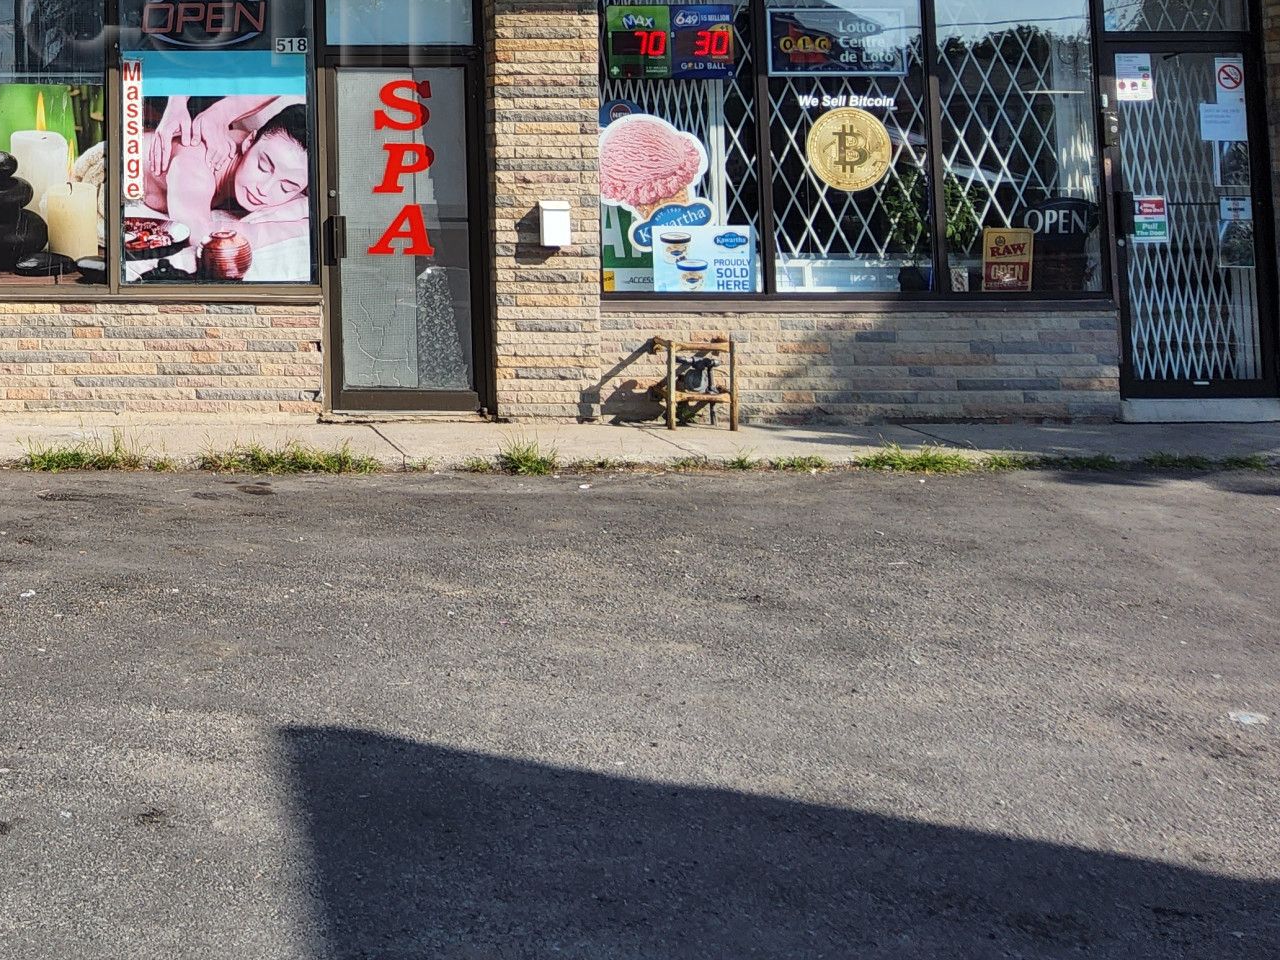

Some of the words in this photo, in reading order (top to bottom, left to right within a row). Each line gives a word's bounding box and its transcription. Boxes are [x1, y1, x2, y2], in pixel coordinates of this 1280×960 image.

[142, 1, 265, 33] OPEN
[838, 22, 876, 33] Lotto
[276, 39, 307, 51] 518
[634, 31, 666, 56] 70
[694, 31, 729, 56] 30
[840, 52, 857, 63] de
[862, 52, 894, 63] Loto
[707, 62, 726, 70] BALL
[798, 96, 819, 107] We
[822, 95, 846, 107] Sell
[849, 95, 895, 107] Bitcoin
[122, 61, 140, 198] Massage
[367, 80, 435, 257] SPA
[1024, 209, 1088, 234] OPEN
[990, 243, 1027, 257] RAW
[713, 259, 752, 267] PROUDLY
[716, 268, 749, 279] SOLD
[991, 264, 1024, 280] OPEN
[717, 280, 749, 290] HERE
